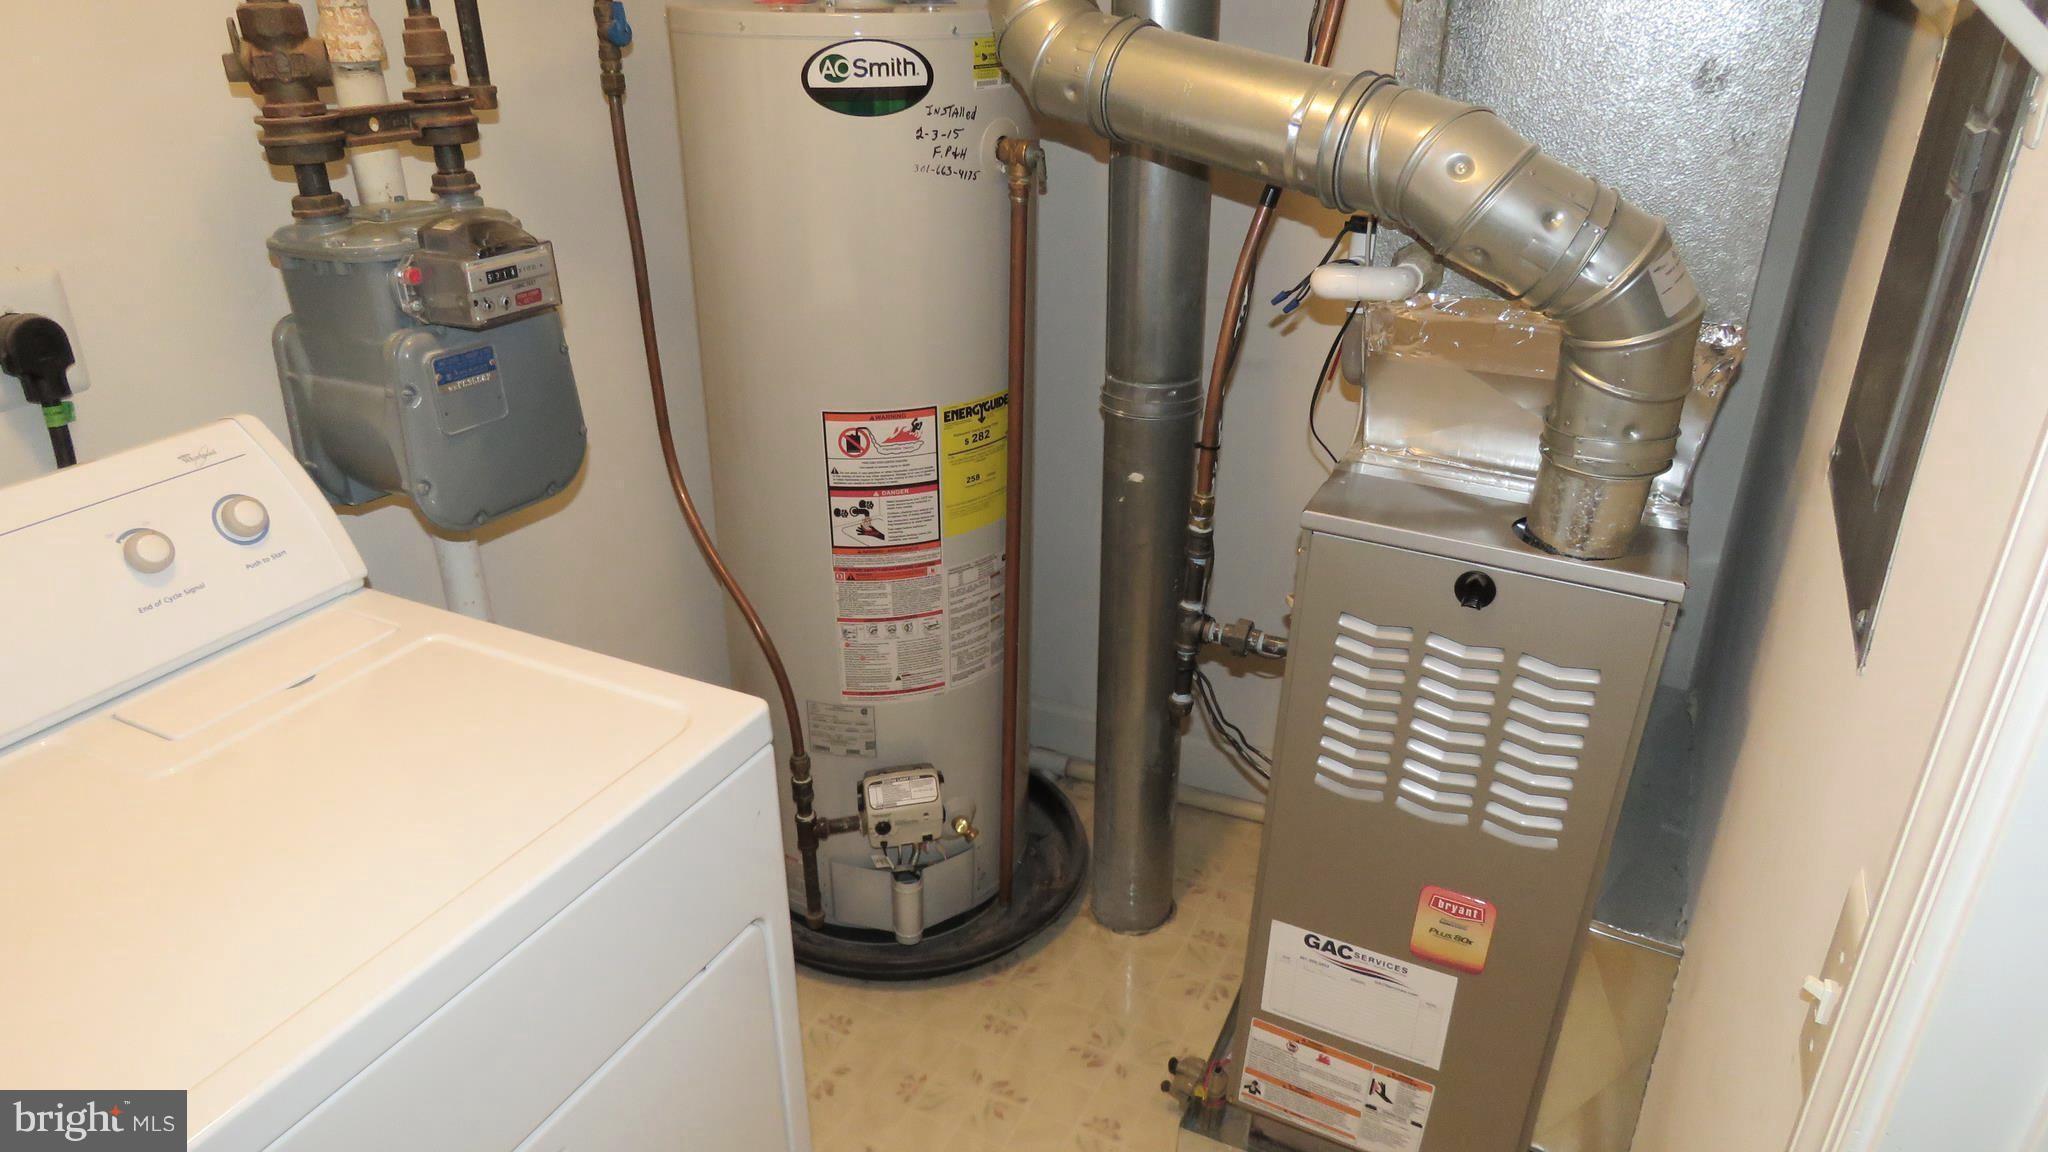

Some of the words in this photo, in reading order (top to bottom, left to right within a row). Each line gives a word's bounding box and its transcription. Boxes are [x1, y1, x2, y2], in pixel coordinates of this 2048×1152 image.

[915, 127, 965, 141] 2-3-15
[971, 429, 991, 444] 282
[881, 488, 910, 496] DANGER
[245, 560, 262, 570] Push
[262, 556, 271, 564] to
[271, 549, 287, 560] Start
[138, 602, 153, 614] End
[154, 598, 163, 609] of
[163, 591, 183, 604] Cycle
[183, 581, 206, 596] Signal
[1438, 899, 1479, 919] bryant
[1303, 932, 1354, 961] GAC
[1354, 952, 1409, 975] SERVICES
